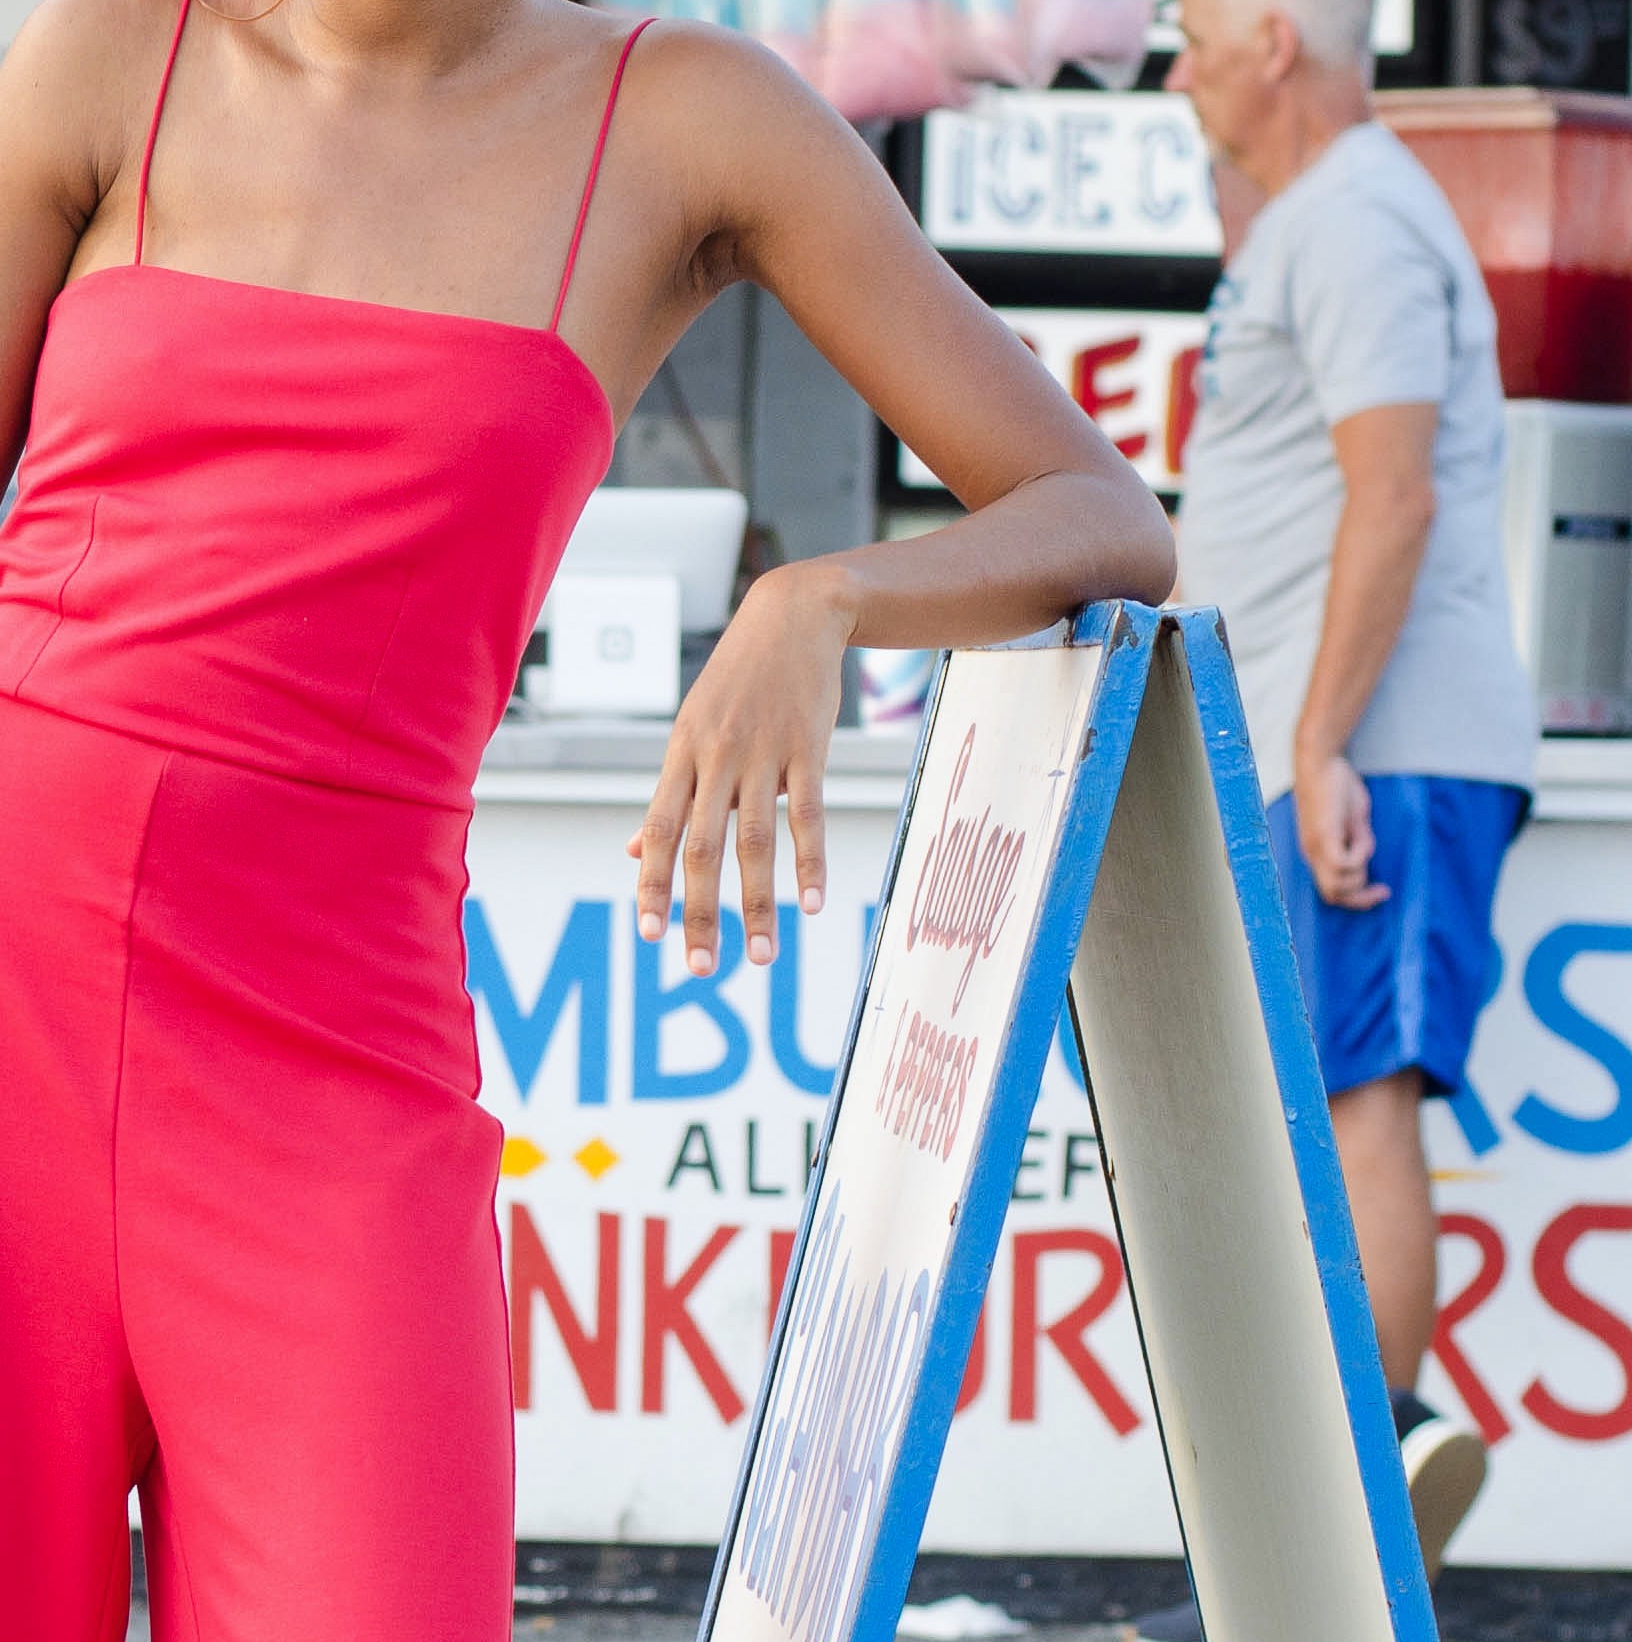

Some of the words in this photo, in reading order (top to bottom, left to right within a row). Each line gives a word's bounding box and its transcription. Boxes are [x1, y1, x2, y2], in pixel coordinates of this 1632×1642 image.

[949, 114, 1114, 227] ICE
[907, 723, 1025, 1018] Sausage
[884, 1011, 979, 1164] PEPPERS
[739, 1177, 865, 1627] CLAM
